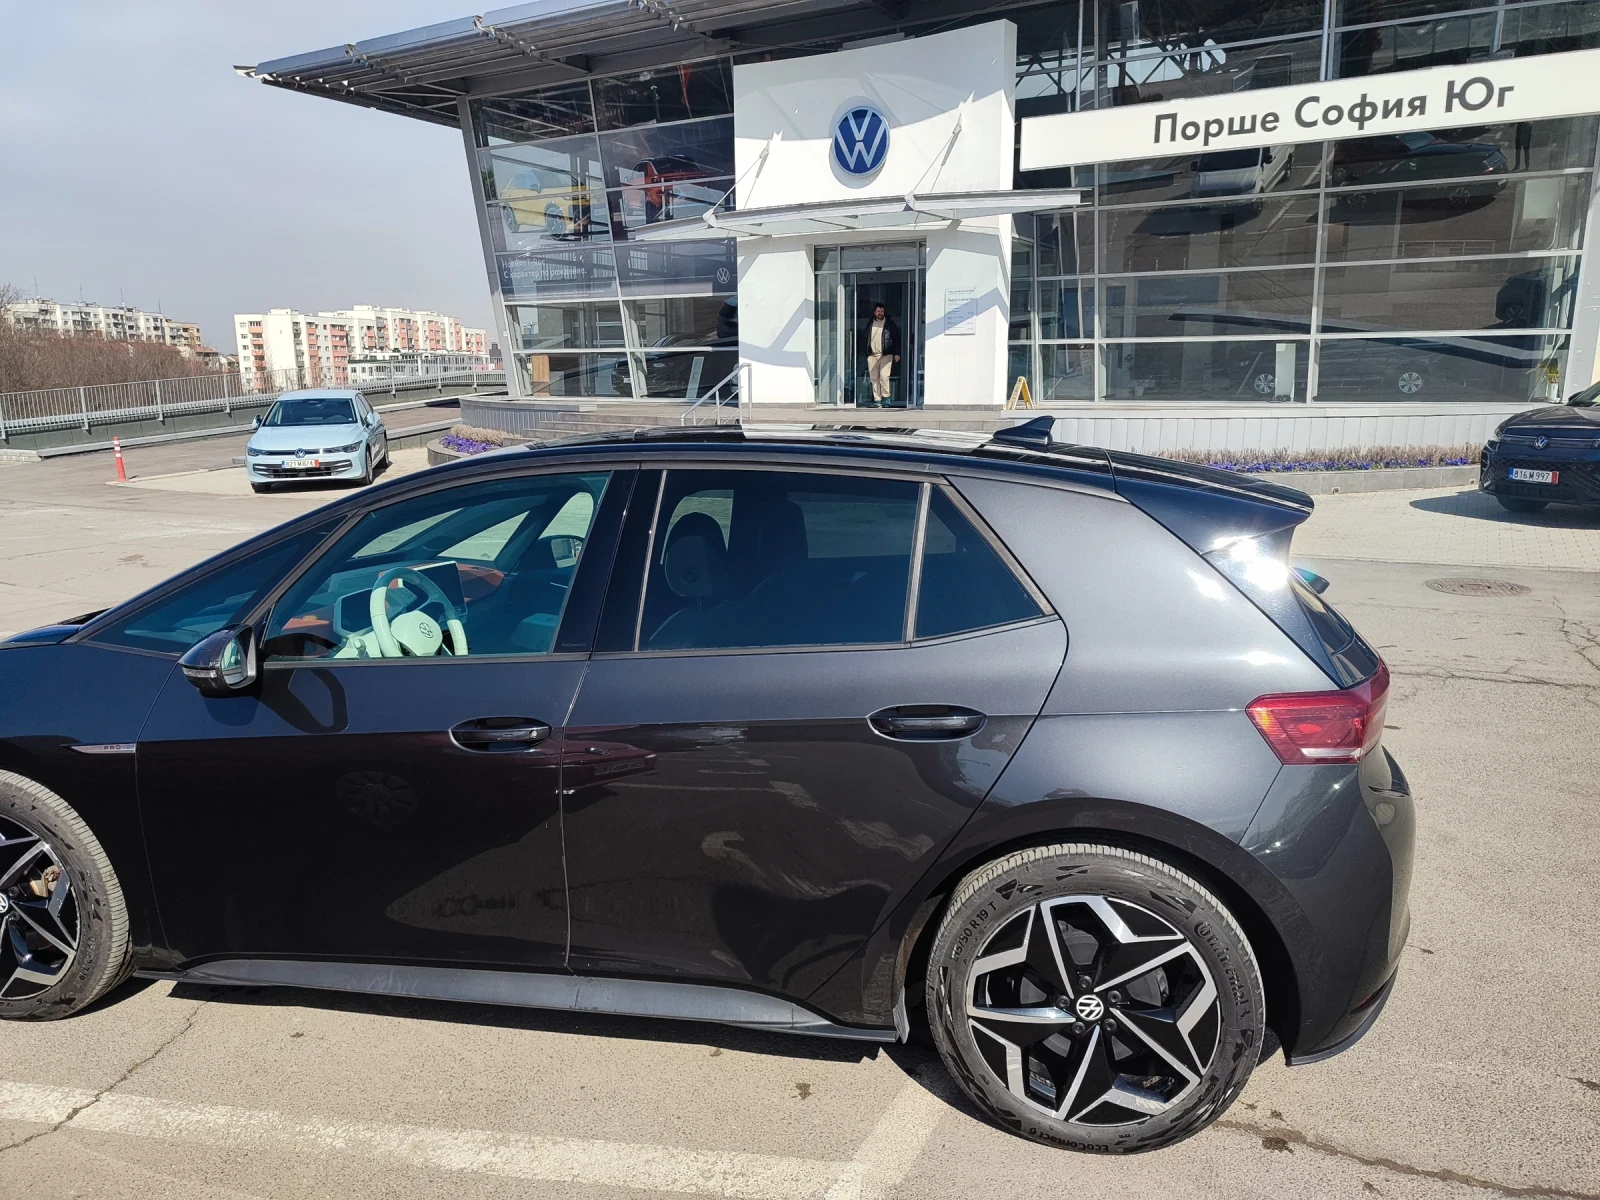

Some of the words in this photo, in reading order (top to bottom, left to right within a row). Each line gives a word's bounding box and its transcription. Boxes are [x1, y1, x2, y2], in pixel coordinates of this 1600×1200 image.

[1154, 112, 1280, 147] Порше
[1294, 93, 1427, 131] София
[1445, 77, 1514, 113] Юг
[977, 908, 990, 923] 19
[1037, 1130, 1109, 1153] EcoContact
